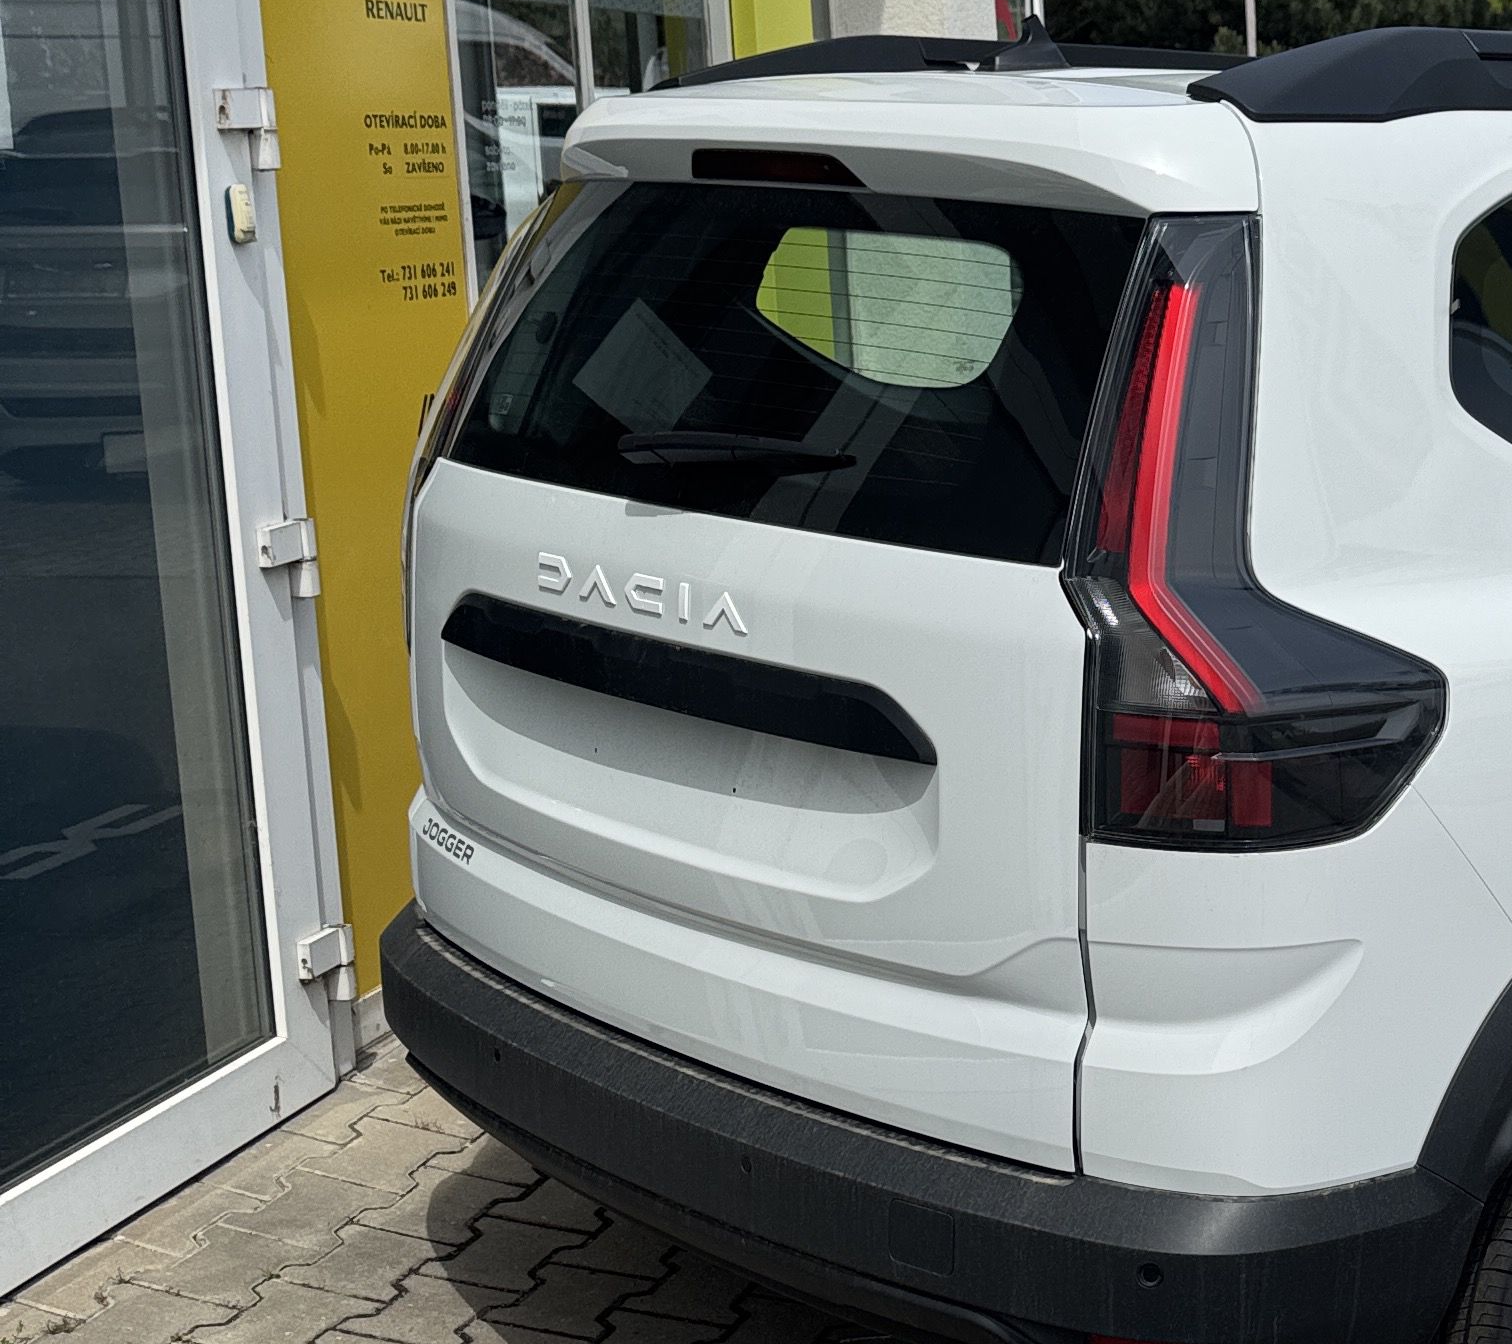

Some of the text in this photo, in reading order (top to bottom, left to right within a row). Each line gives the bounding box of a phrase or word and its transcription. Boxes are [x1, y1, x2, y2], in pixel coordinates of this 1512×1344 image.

[365, 0, 428, 22] RENAULT
[364, 110, 447, 129] OTEVÍRACÍ DOBA
[405, 159, 445, 174] ZAVŘENO
[401, 264, 417, 280] 731
[421, 262, 437, 278] 606
[439, 261, 455, 277] 241
[402, 285, 418, 301] 731
[422, 283, 438, 299] 606
[537, 551, 749, 637] DACIA
[422, 818, 475, 866] JOGGER
